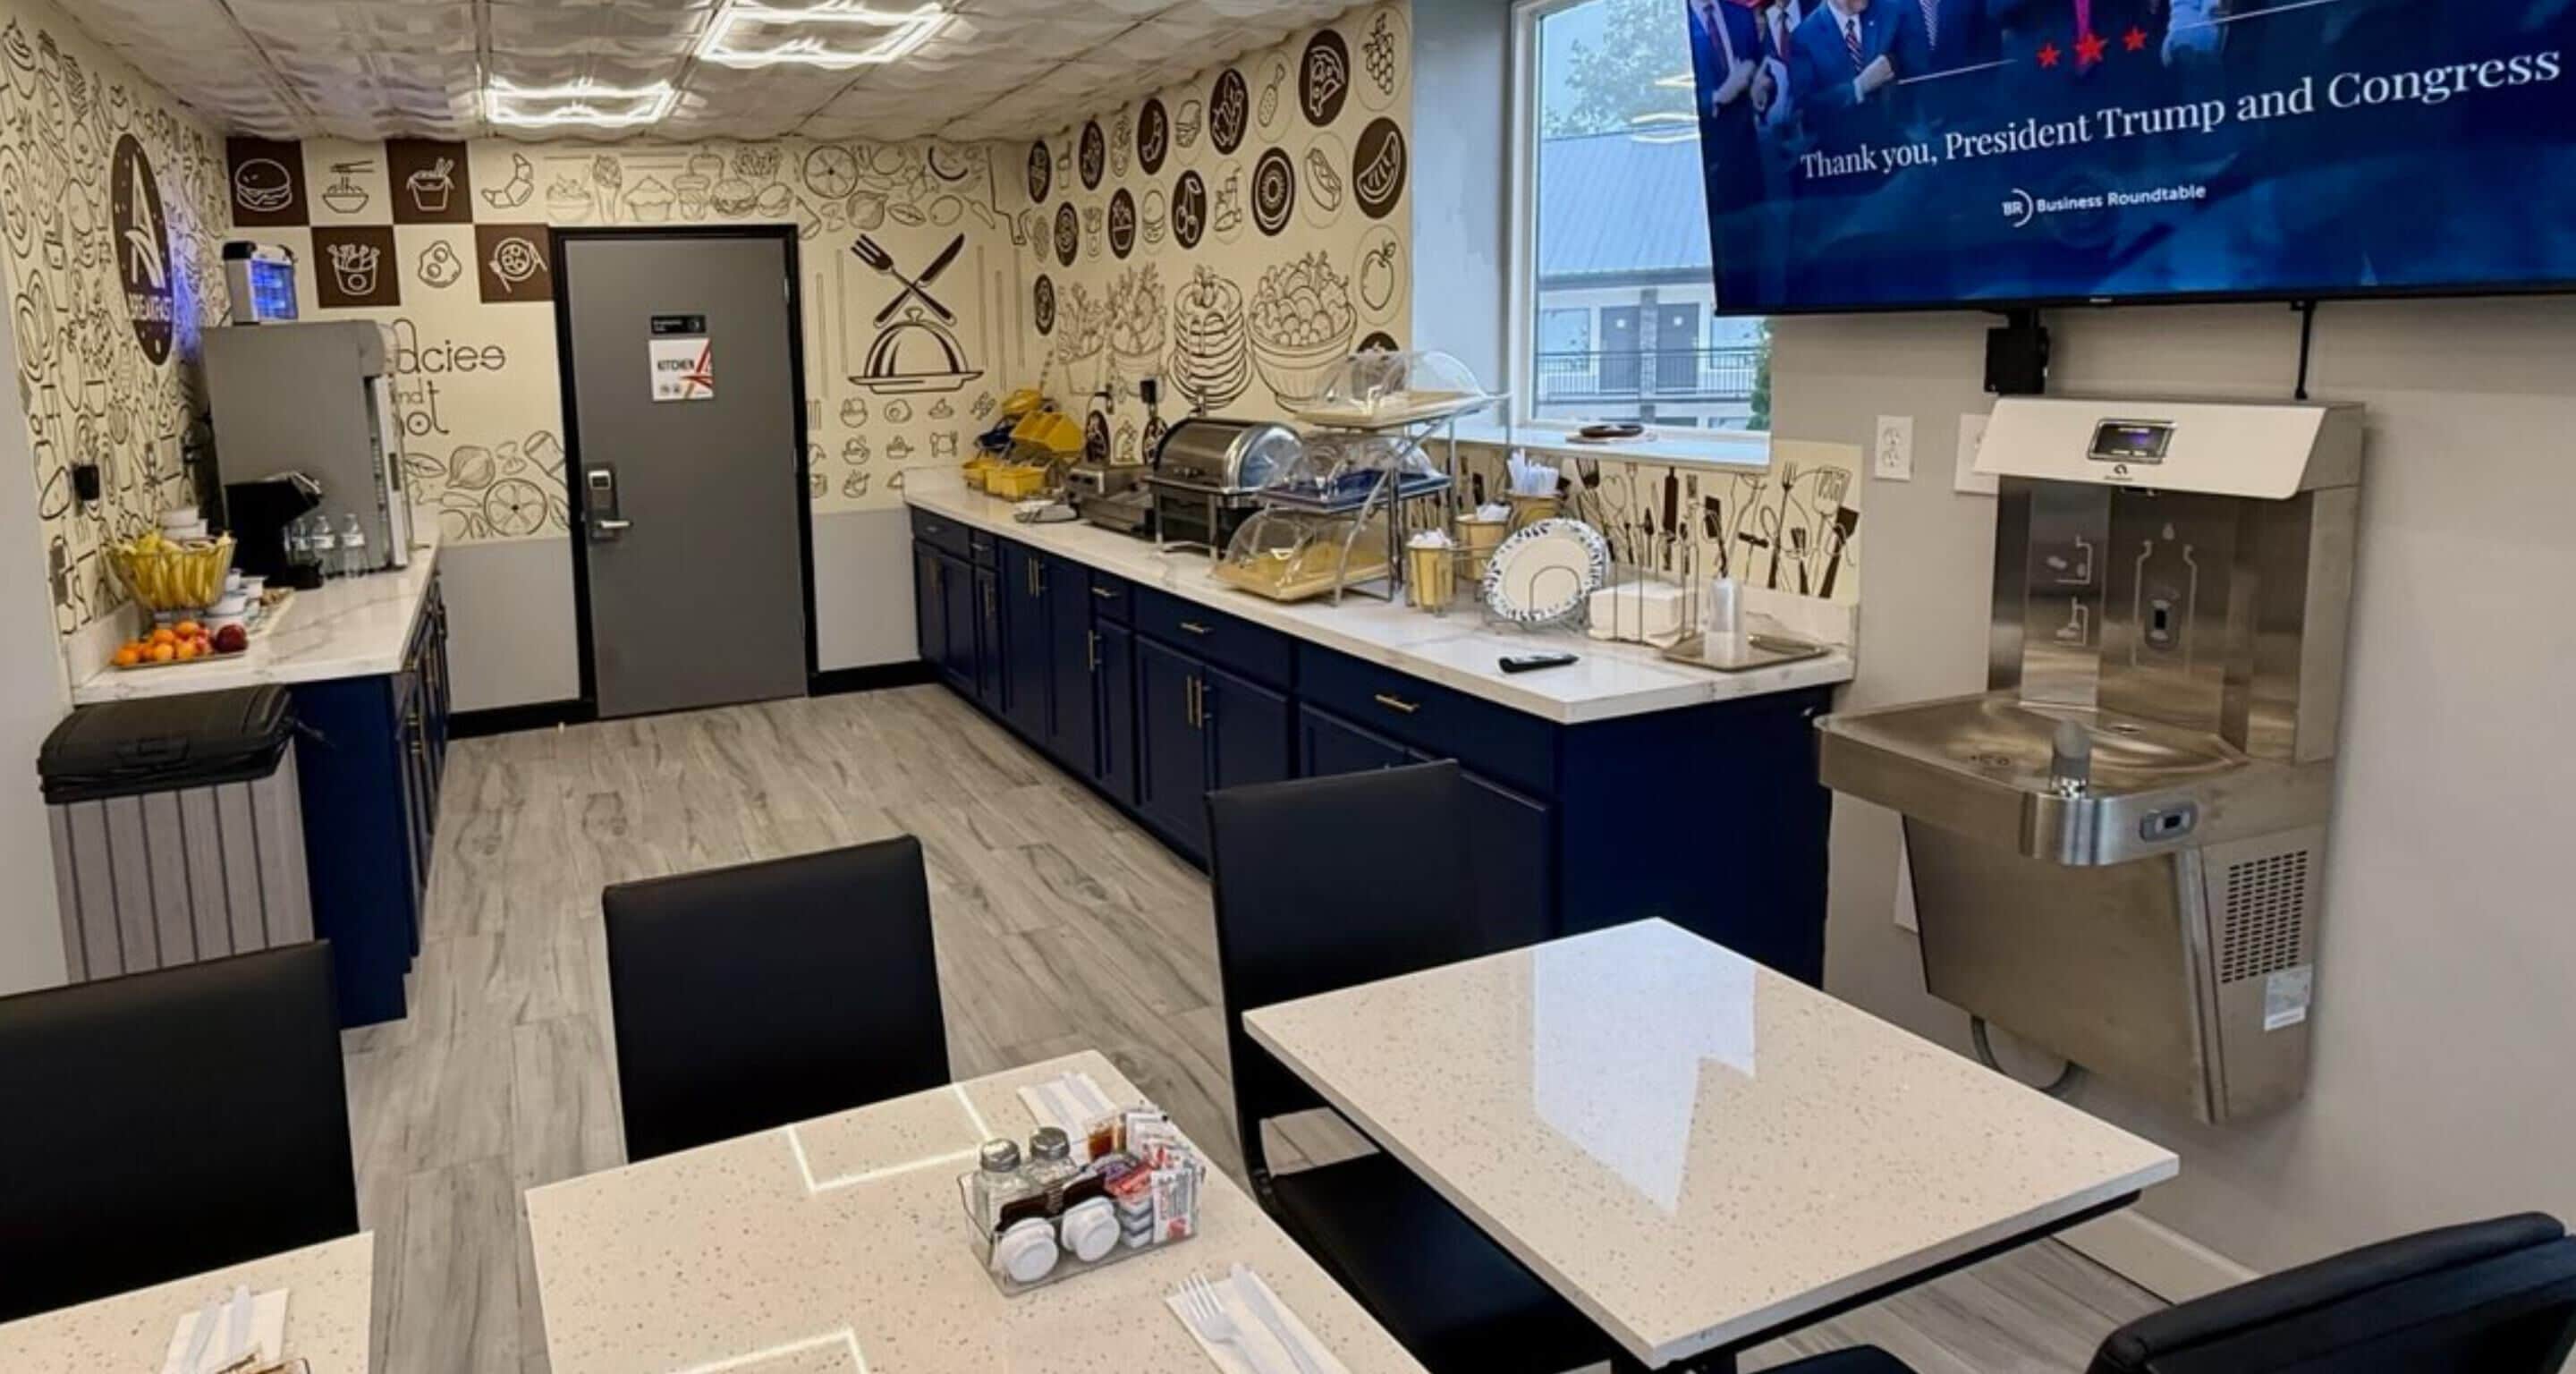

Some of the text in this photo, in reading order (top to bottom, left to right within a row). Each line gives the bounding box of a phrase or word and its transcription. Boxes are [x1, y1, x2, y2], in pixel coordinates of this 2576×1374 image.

[1800, 49, 2562, 179] Thank you, President Trump and Congress
[2037, 194, 2104, 213] Business
[2107, 183, 2207, 207] Roundtable
[392, 317, 505, 375] acies
[657, 359, 695, 372] KITCHEN
